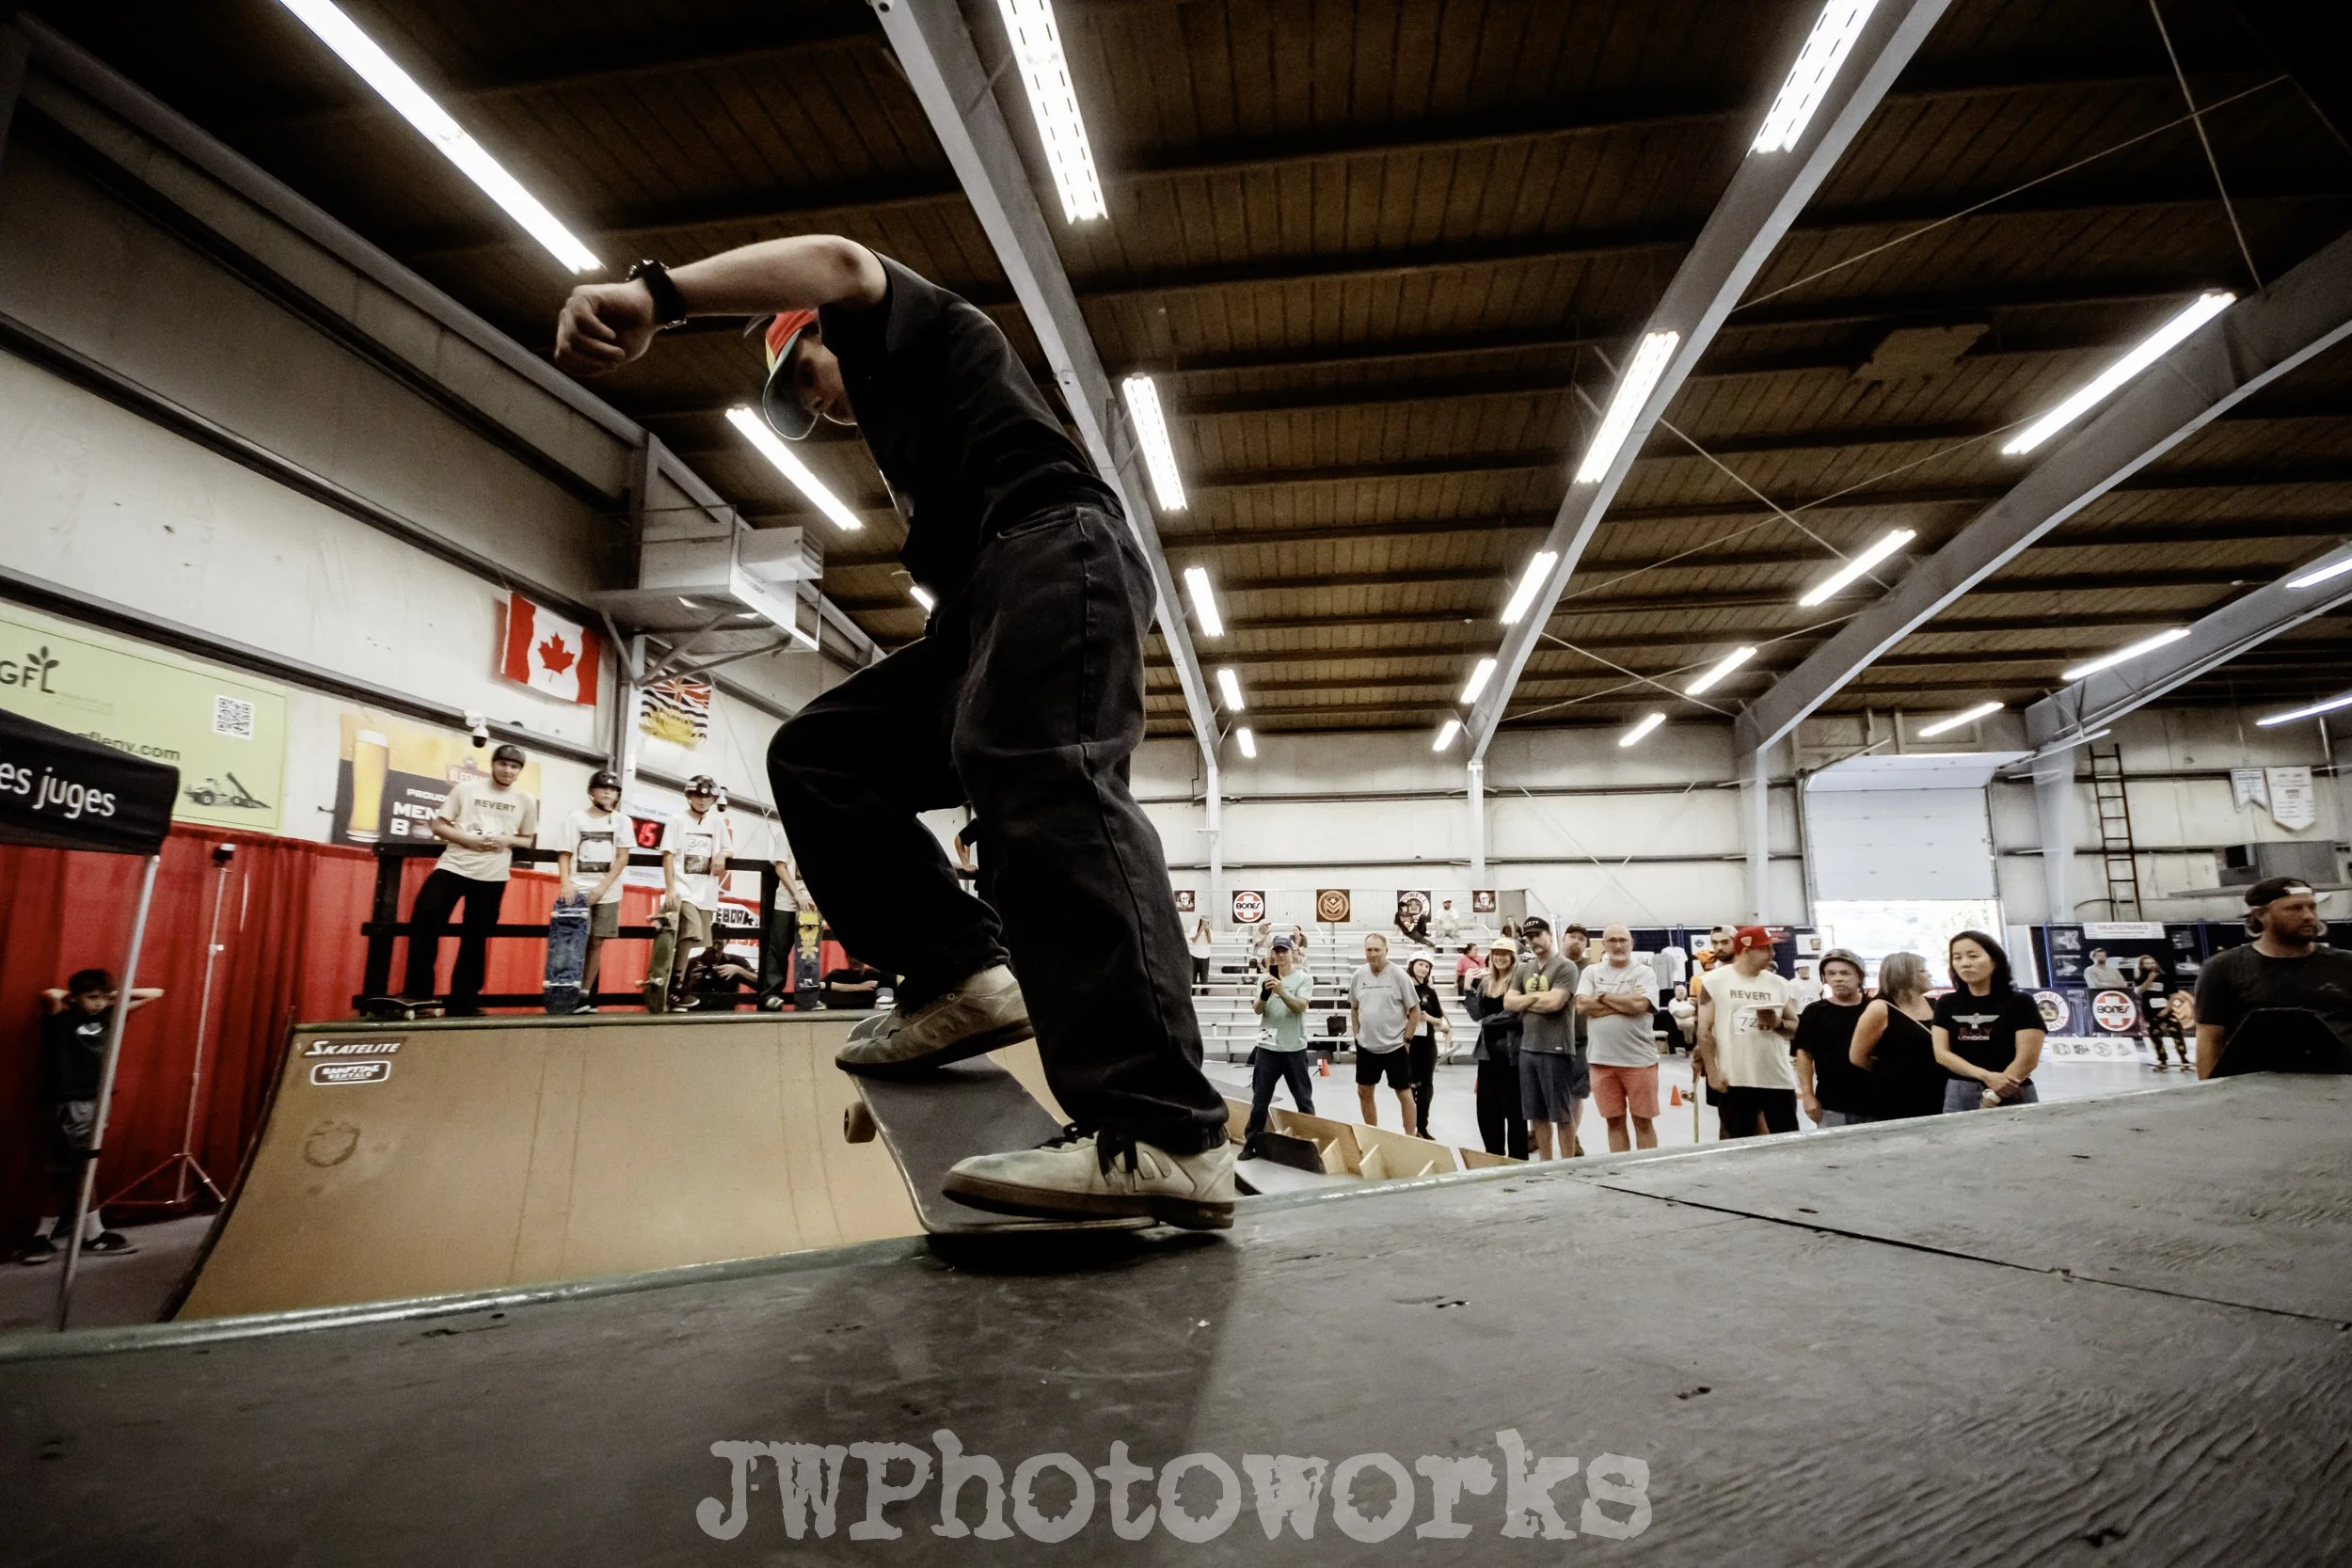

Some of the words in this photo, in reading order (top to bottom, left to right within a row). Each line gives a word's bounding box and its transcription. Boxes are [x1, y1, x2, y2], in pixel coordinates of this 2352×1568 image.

[0, 658, 58, 694] GFL
[32, 767, 116, 819] juges
[474, 799, 516, 813] REVERT
[1730, 990, 1772, 1001] REVERT
[304, 1040, 401, 1055] SKATELITE
